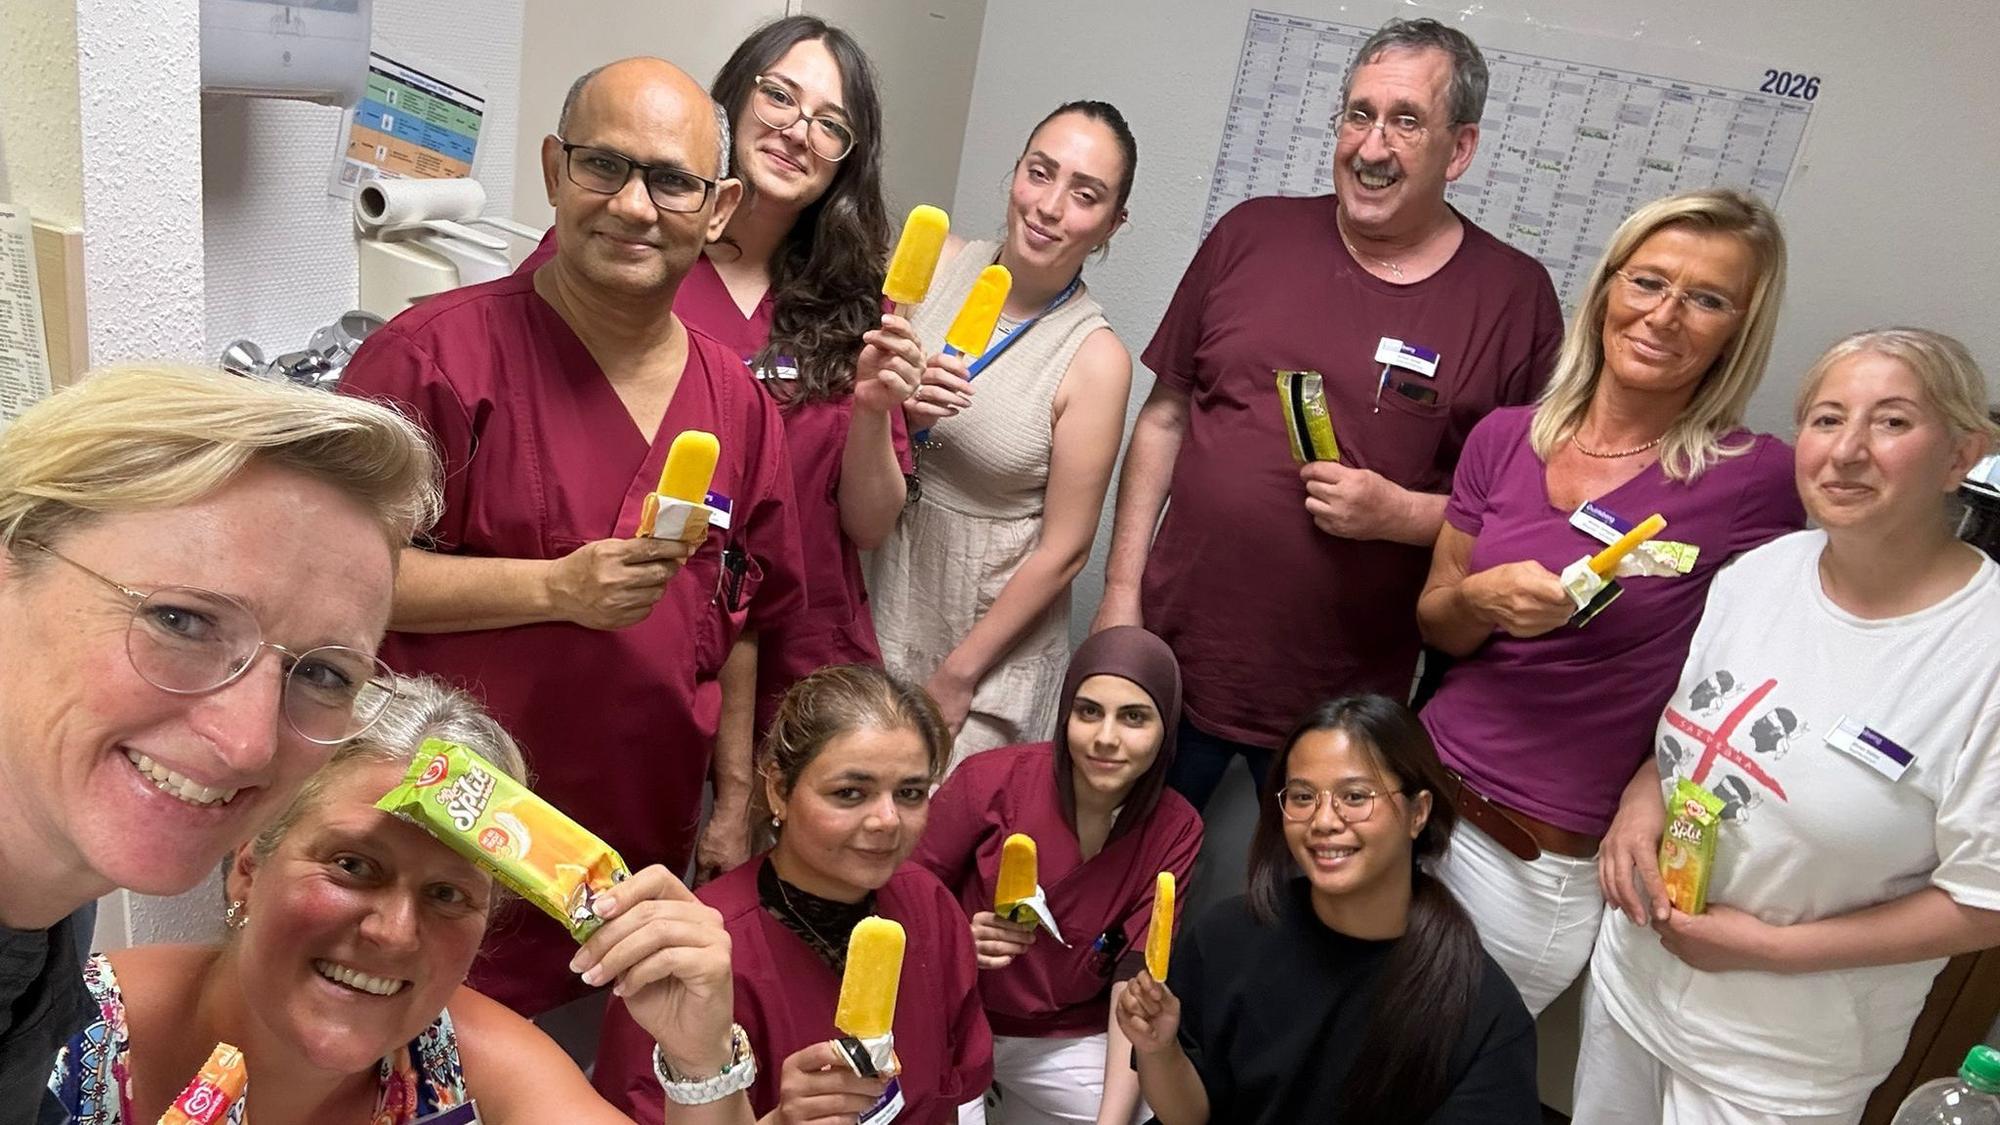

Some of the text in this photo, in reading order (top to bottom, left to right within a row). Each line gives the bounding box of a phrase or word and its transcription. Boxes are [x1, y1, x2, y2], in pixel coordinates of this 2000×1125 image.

[1760, 69, 1820, 101] 2026
[447, 765, 491, 831] Split
[1669, 820, 1702, 840] Split
